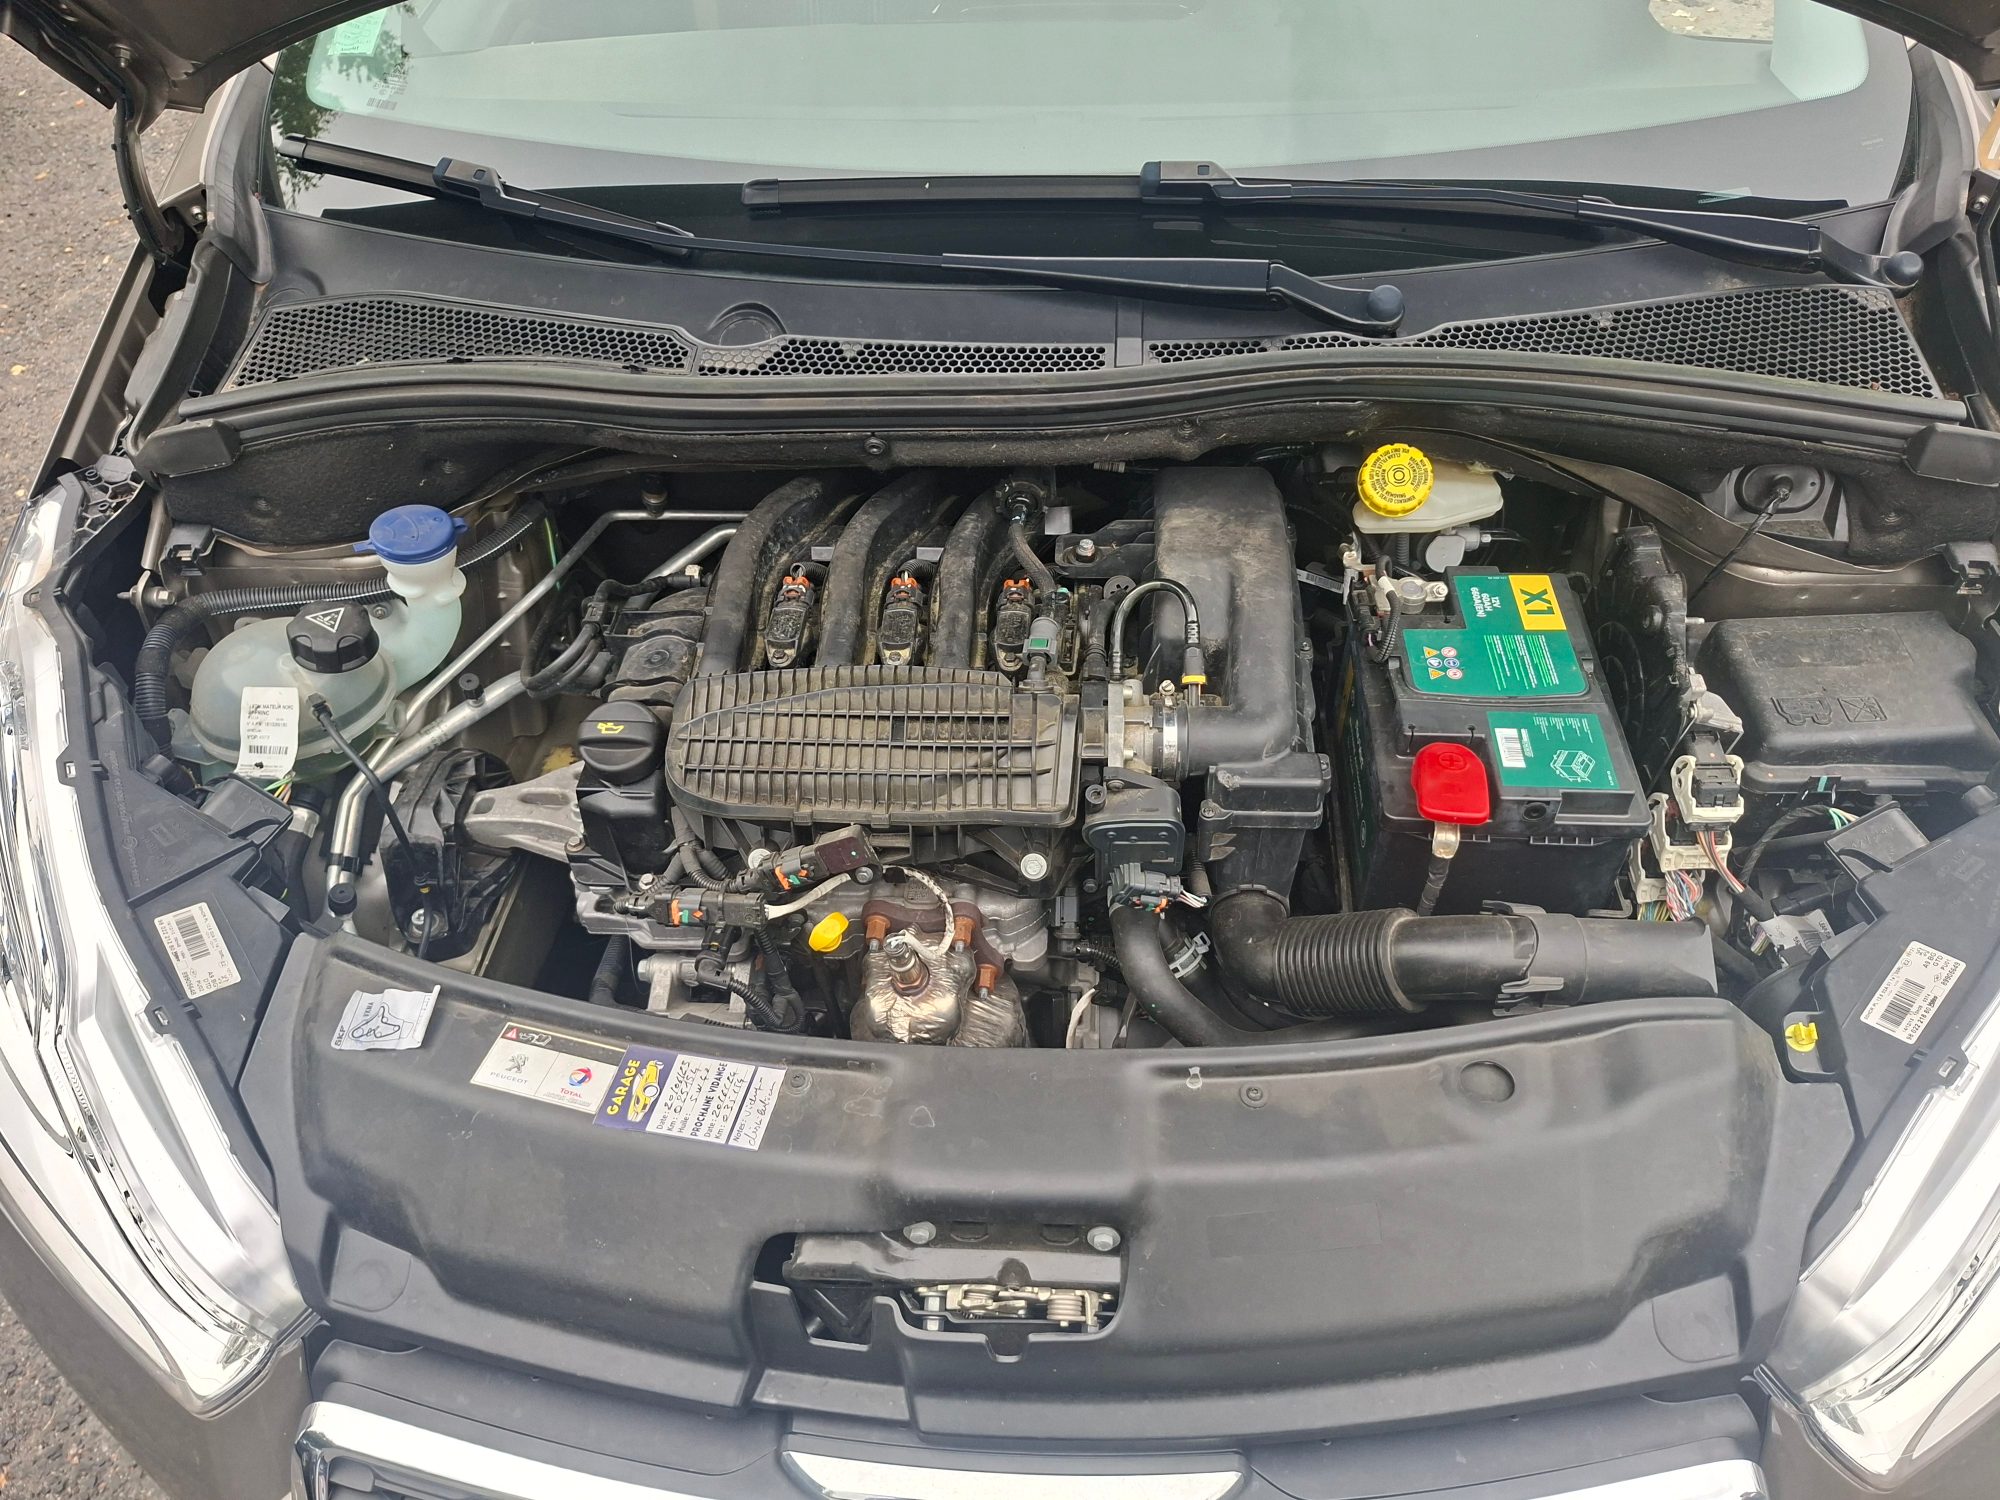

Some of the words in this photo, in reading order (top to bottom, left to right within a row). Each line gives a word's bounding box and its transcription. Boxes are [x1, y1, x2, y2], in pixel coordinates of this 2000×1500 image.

[1481, 593, 1493, 611] 60AH
[1491, 596, 1501, 608] 12V
[1520, 588, 1555, 615] X1
[490, 1071, 528, 1085] PEUGEOT
[607, 1059, 640, 1115] GARAGE
[560, 1087, 583, 1099] TOTAL
[690, 1094, 714, 1137] PROCHAINE
[708, 1062, 728, 1097] VIDANGE
[656, 1112, 669, 1130] Date:
[666, 1116, 677, 1132] Km:
[677, 1113, 691, 1134] Huile:
[704, 1118, 717, 1137] Date:
[714, 1124, 727, 1140] Km:
[733, 1119, 747, 1142] Notes:
